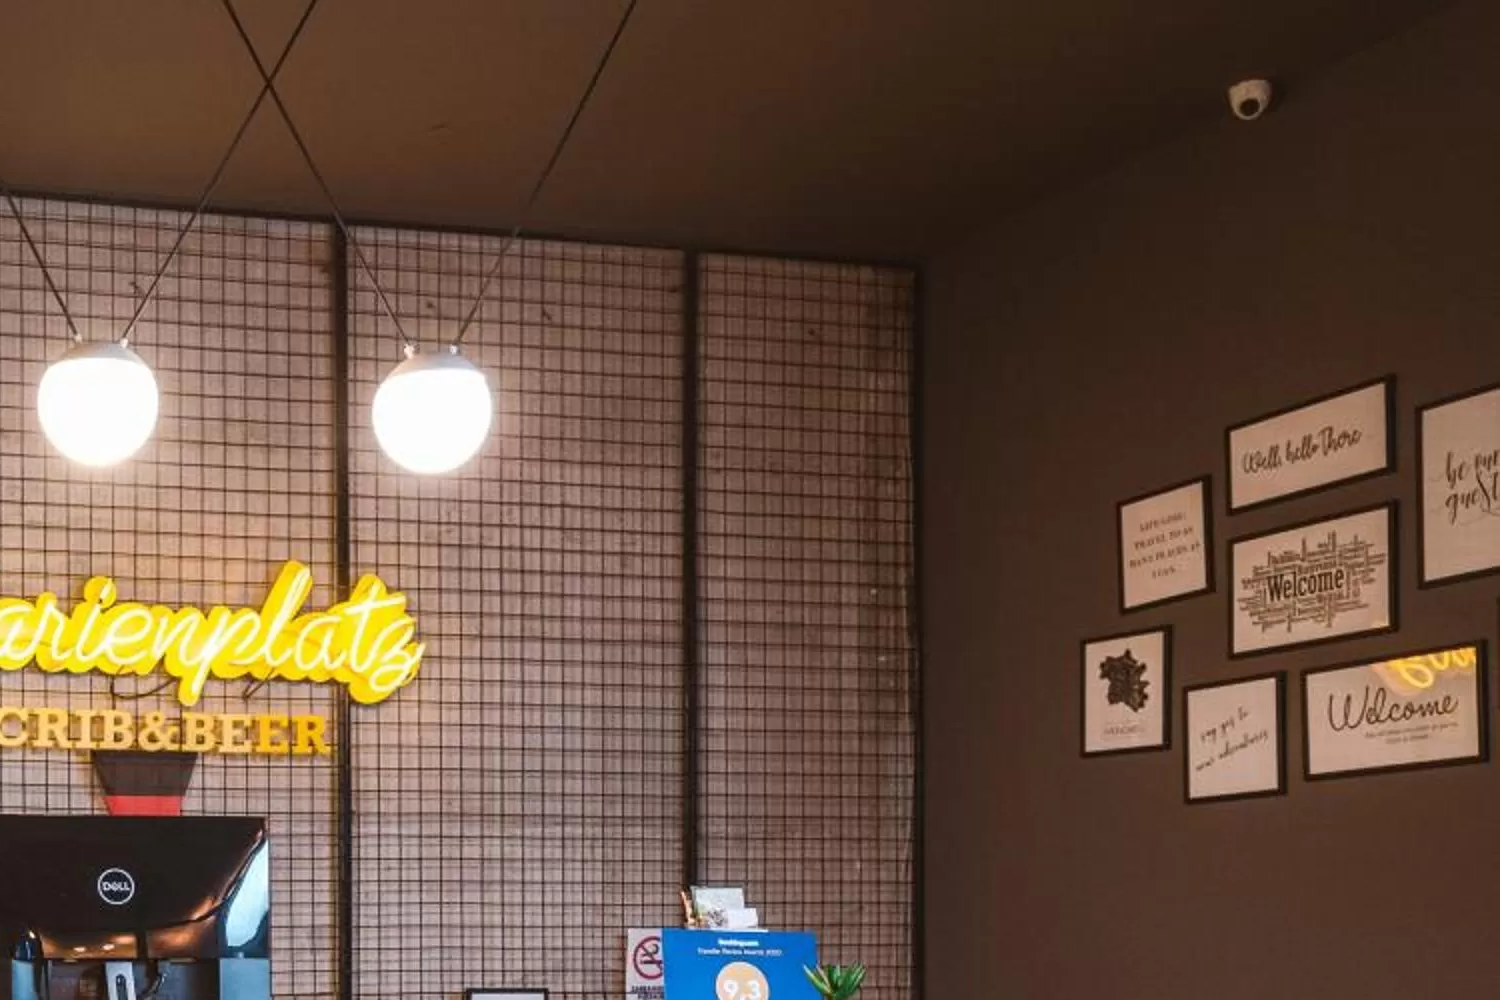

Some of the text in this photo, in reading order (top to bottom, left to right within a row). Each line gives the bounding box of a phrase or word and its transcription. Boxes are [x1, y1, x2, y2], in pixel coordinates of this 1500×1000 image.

[1286, 433, 1319, 464] hello
[1267, 568, 1344, 602] Welcome
[1328, 685, 1459, 731] Welcome
[102, 881, 131, 892] DELL
